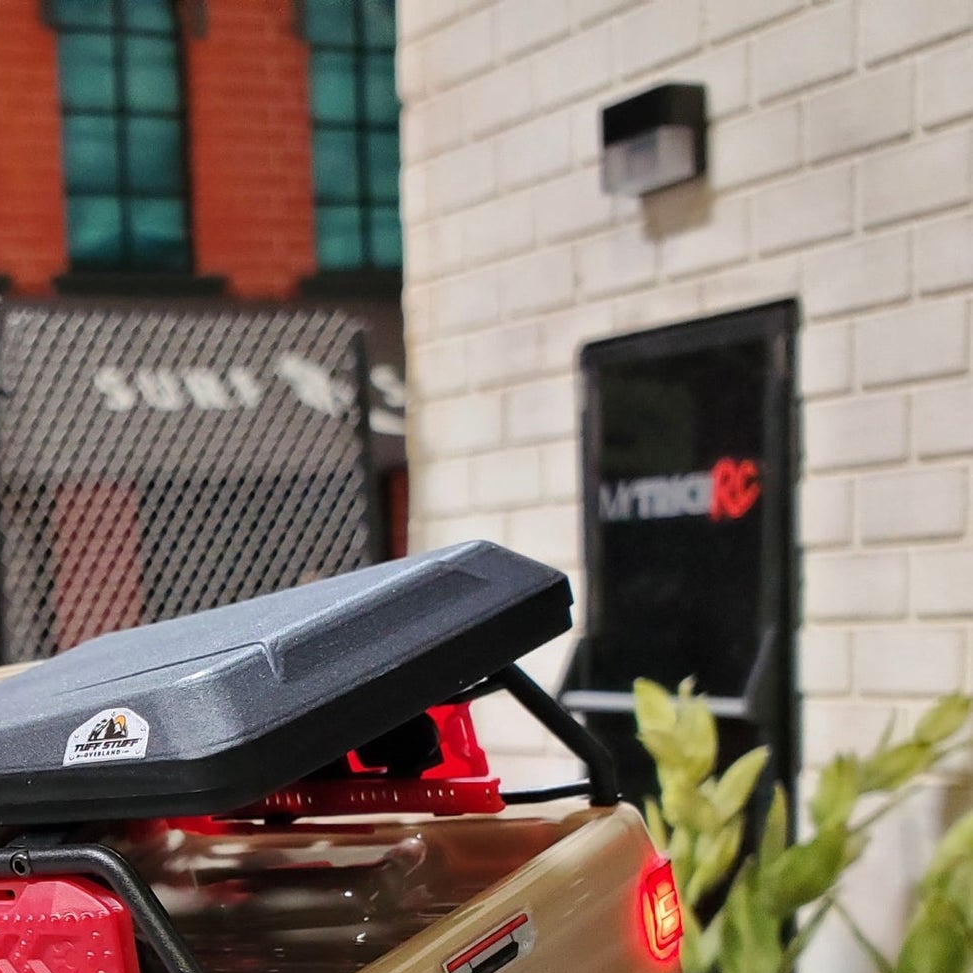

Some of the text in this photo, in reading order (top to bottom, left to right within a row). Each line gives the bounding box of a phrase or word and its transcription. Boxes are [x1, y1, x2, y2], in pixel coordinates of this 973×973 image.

[74, 738, 140, 752] TUFF STUFF
[83, 749, 121, 758] OVERLAND
